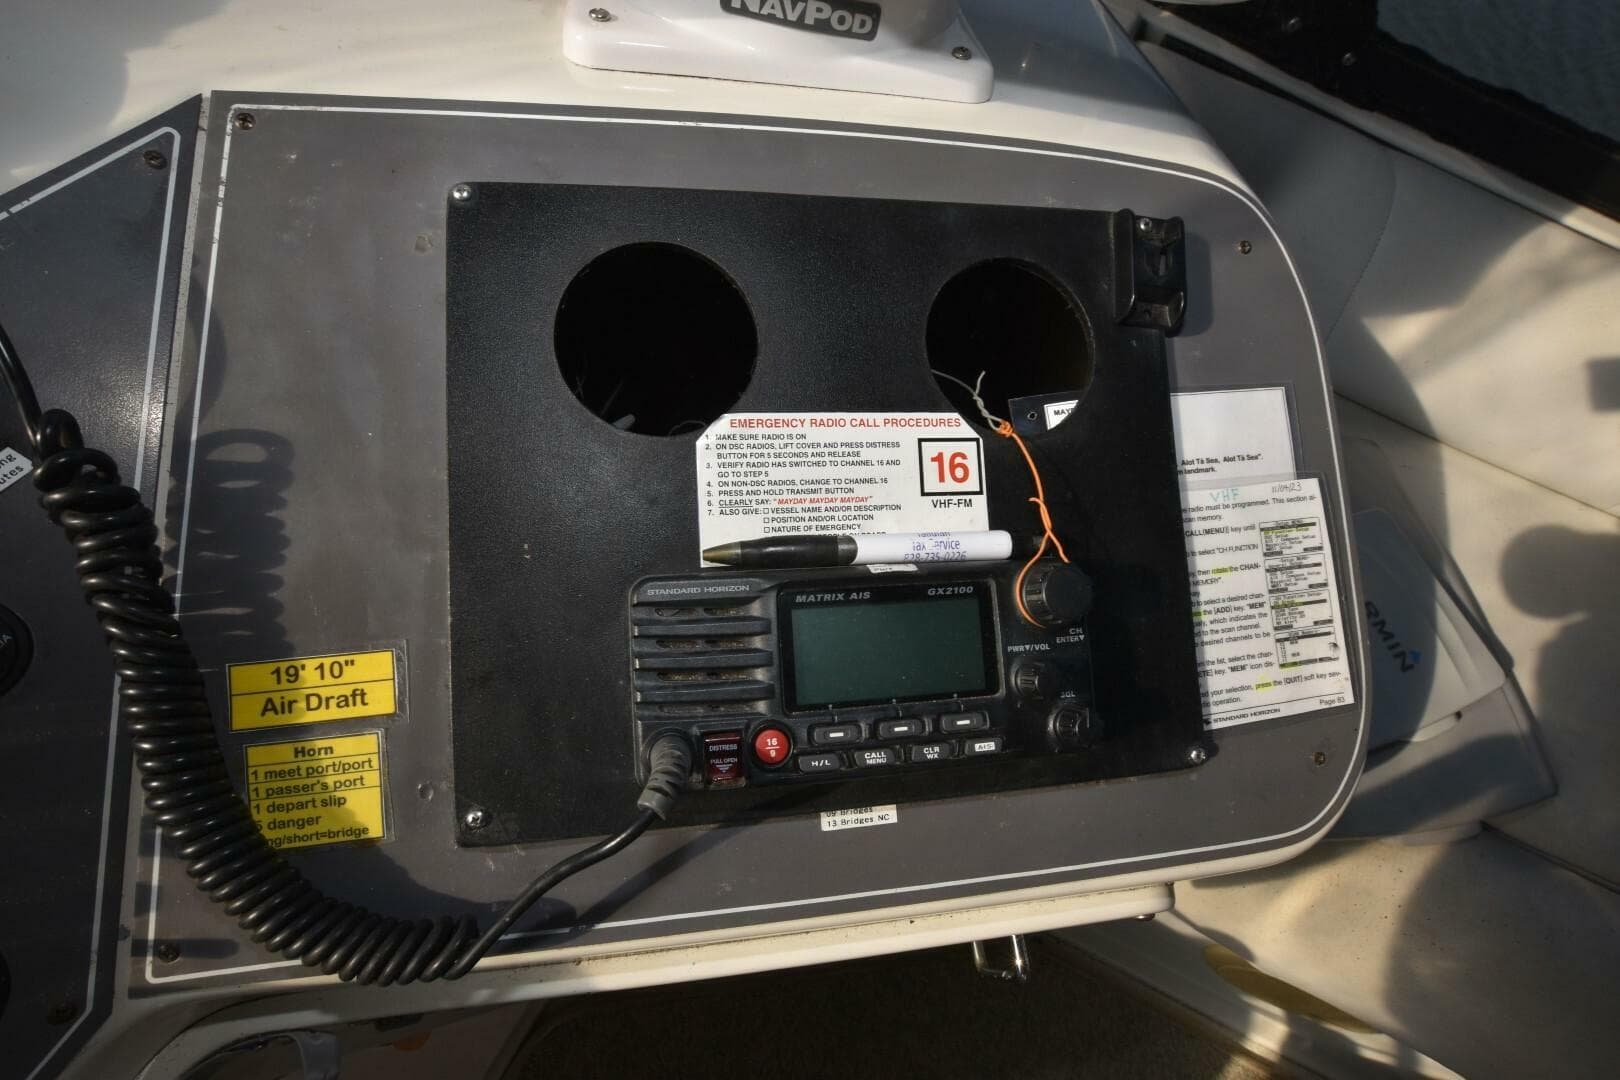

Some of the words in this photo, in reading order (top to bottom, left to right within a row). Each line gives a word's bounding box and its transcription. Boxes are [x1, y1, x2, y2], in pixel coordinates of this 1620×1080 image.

[730, 418, 806, 428] EMERGENCY
[810, 418, 846, 428] RADIO
[850, 418, 880, 427] CALL
[884, 418, 960, 427] PROCEDURES
[930, 452, 969, 483] 16
[800, 478, 830, 486] CHANGE
[1210, 488, 1240, 502] VHF
[718, 499, 753, 507] CLEARLY
[854, 504, 901, 512] DESCRIPTION
[931, 498, 972, 509] VHF-FM
[815, 524, 861, 532] EMERGENCY
[647, 587, 701, 596] STANDARD
[704, 585, 749, 593] HORIZON
[928, 586, 973, 596] GX2100
[795, 593, 844, 602] MATRIX
[849, 592, 871, 600] AIS
[1069, 627, 1083, 635] CH
[1365, 602, 1414, 673] RMIN
[270, 664, 306, 685] 19'
[314, 660, 355, 680] 10"
[260, 696, 298, 717] Air
[305, 688, 368, 712] Draft
[766, 738, 778, 746] 16
[294, 746, 334, 758] Horn
[709, 744, 738, 752] DISTRESS
[924, 746, 939, 754] CLR
[251, 770, 258, 780] 1
[264, 765, 303, 780] meet
[306, 758, 373, 776] port/port
[252, 787, 259, 798] 1
[266, 780, 328, 797] passer's
[334, 776, 365, 792] port
[253, 804, 260, 814] 1
[266, 798, 317, 814] depart
[320, 795, 346, 808] slip
[267, 815, 322, 831] danger
[841, 818, 874, 826] Bridges
